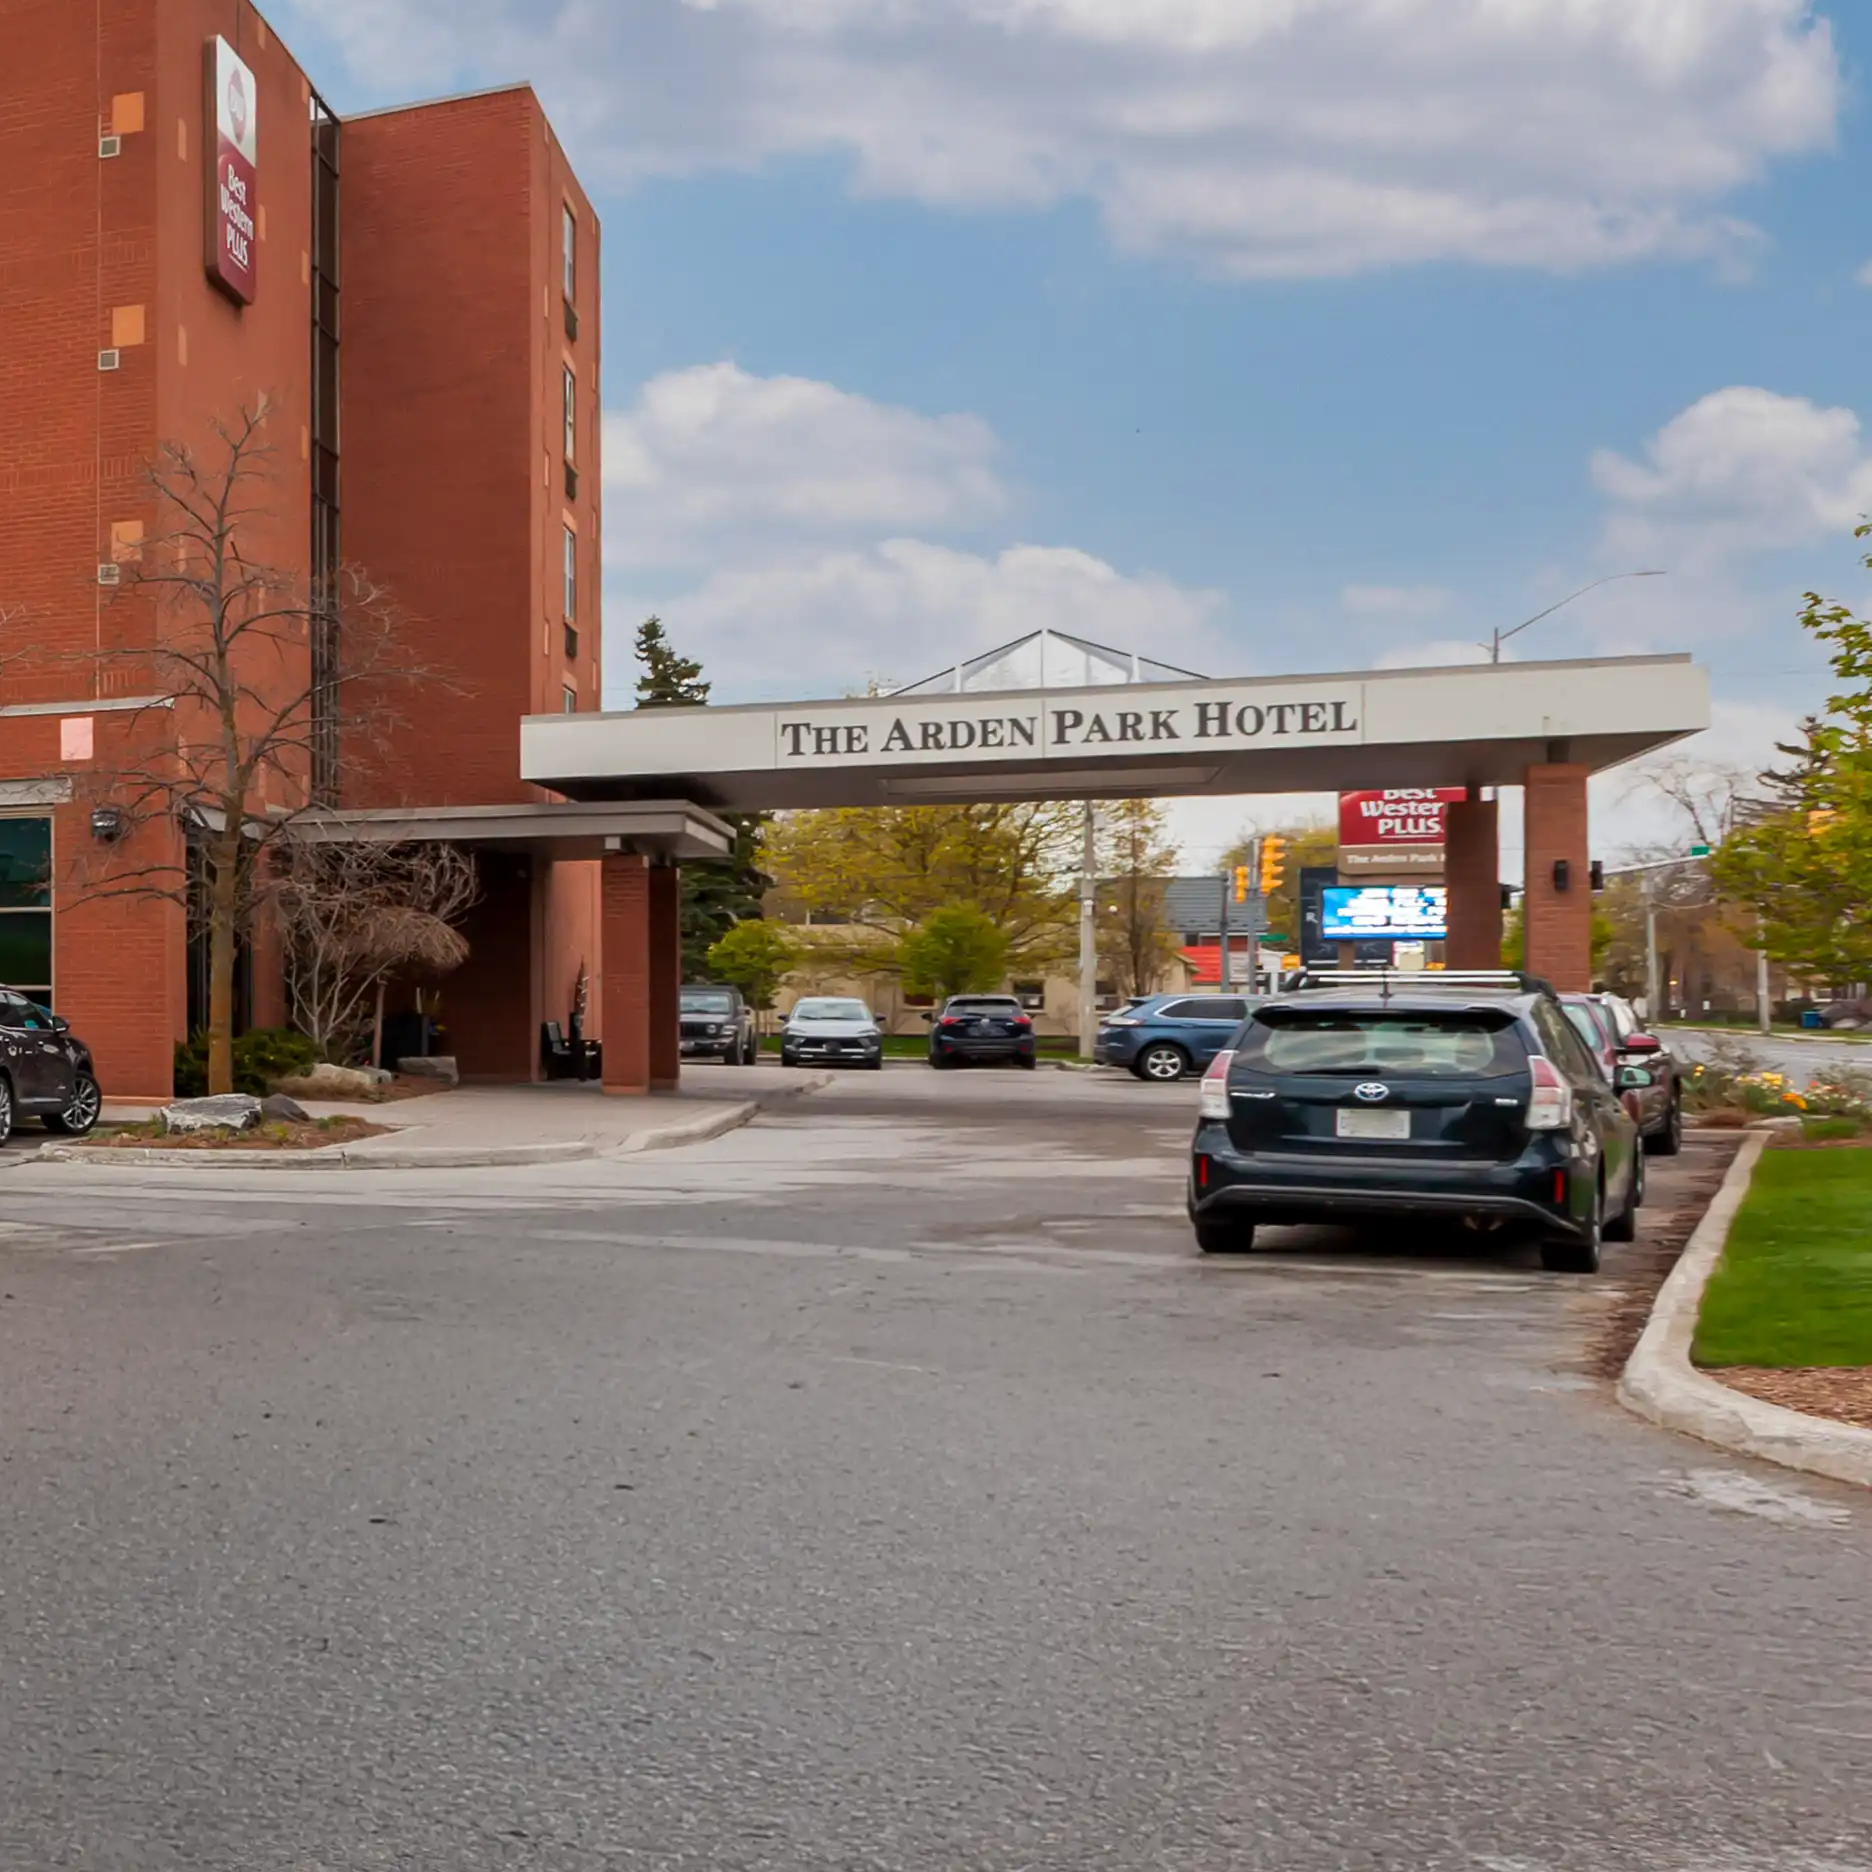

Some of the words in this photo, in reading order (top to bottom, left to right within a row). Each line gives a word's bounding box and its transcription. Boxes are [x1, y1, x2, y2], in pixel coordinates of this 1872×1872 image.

[227, 164, 246, 206] Best
[220, 183, 254, 241] Western
[226, 223, 249, 266] PLUS
[781, 721, 869, 756] THE
[880, 716, 1038, 753] ARDEN
[1051, 709, 1181, 746] PARK
[1194, 700, 1358, 738] HOTEL
[1360, 801, 1445, 817] Wester
[1378, 817, 1441, 835] PLUS
